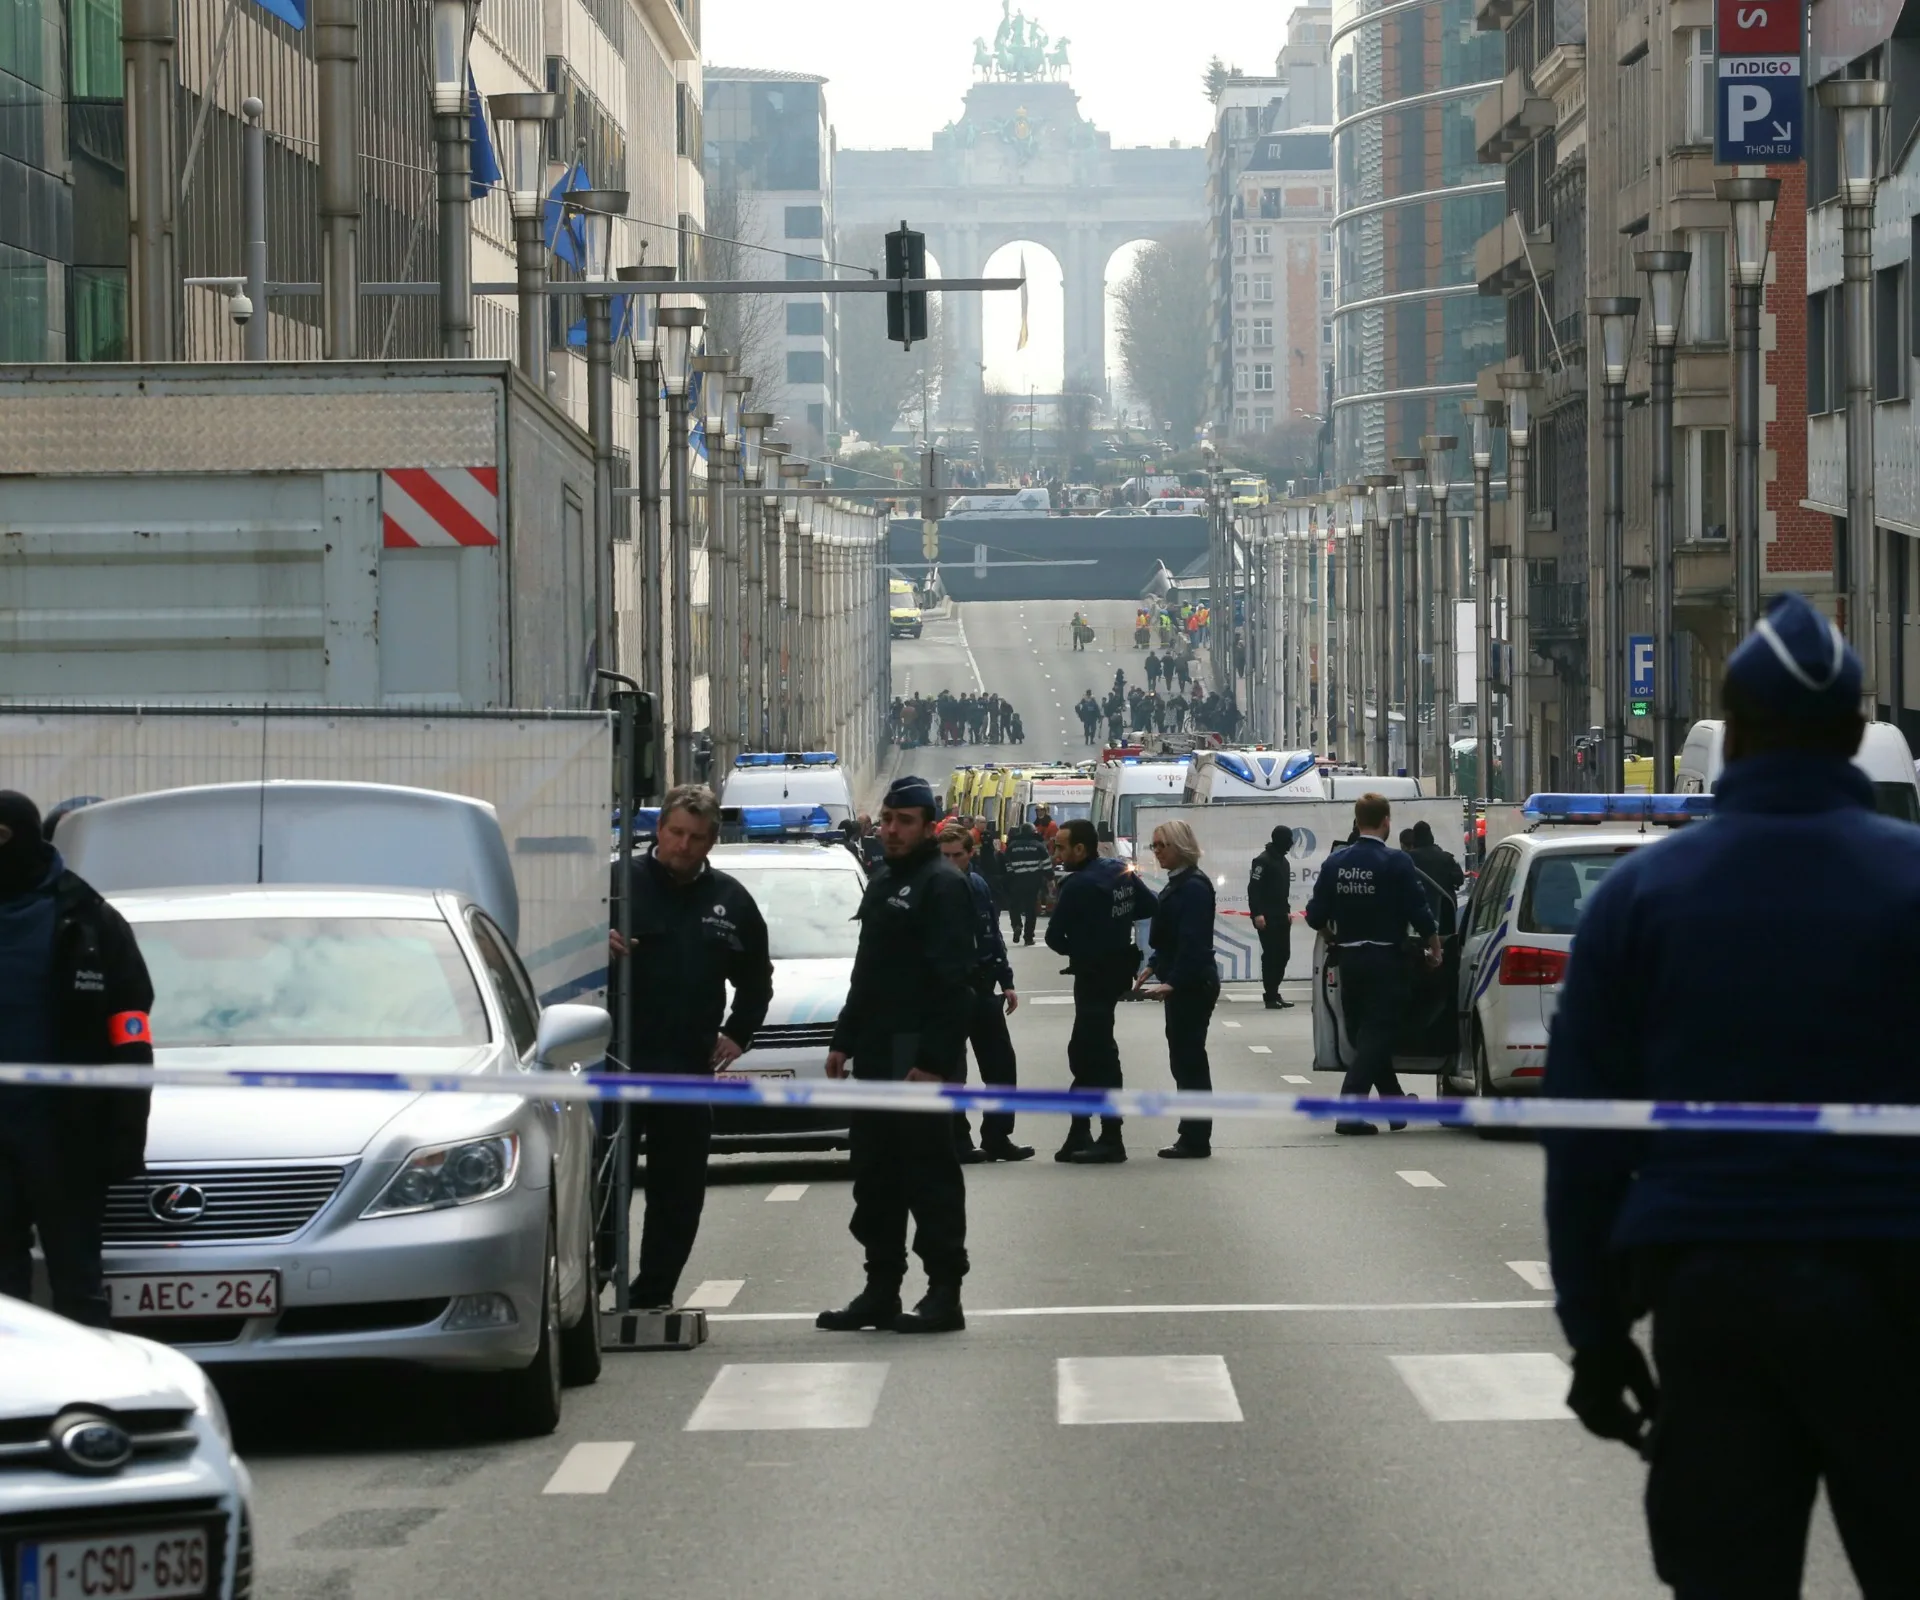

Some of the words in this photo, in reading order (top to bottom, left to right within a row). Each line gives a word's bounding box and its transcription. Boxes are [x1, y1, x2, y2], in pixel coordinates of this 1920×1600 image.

[1730, 61, 1792, 75] INDIGO
[1728, 84, 1772, 142] P
[1745, 145, 1774, 154] THON
[1777, 145, 1791, 154] EU
[1634, 686, 1648, 695] LOI
[1337, 867, 1374, 880] Police
[1336, 881, 1376, 895] Politie
[1215, 894, 1243, 903] ruxelles
[75, 969, 104, 981] Police
[44, 1537, 204, 1599] 1-CSO-636
